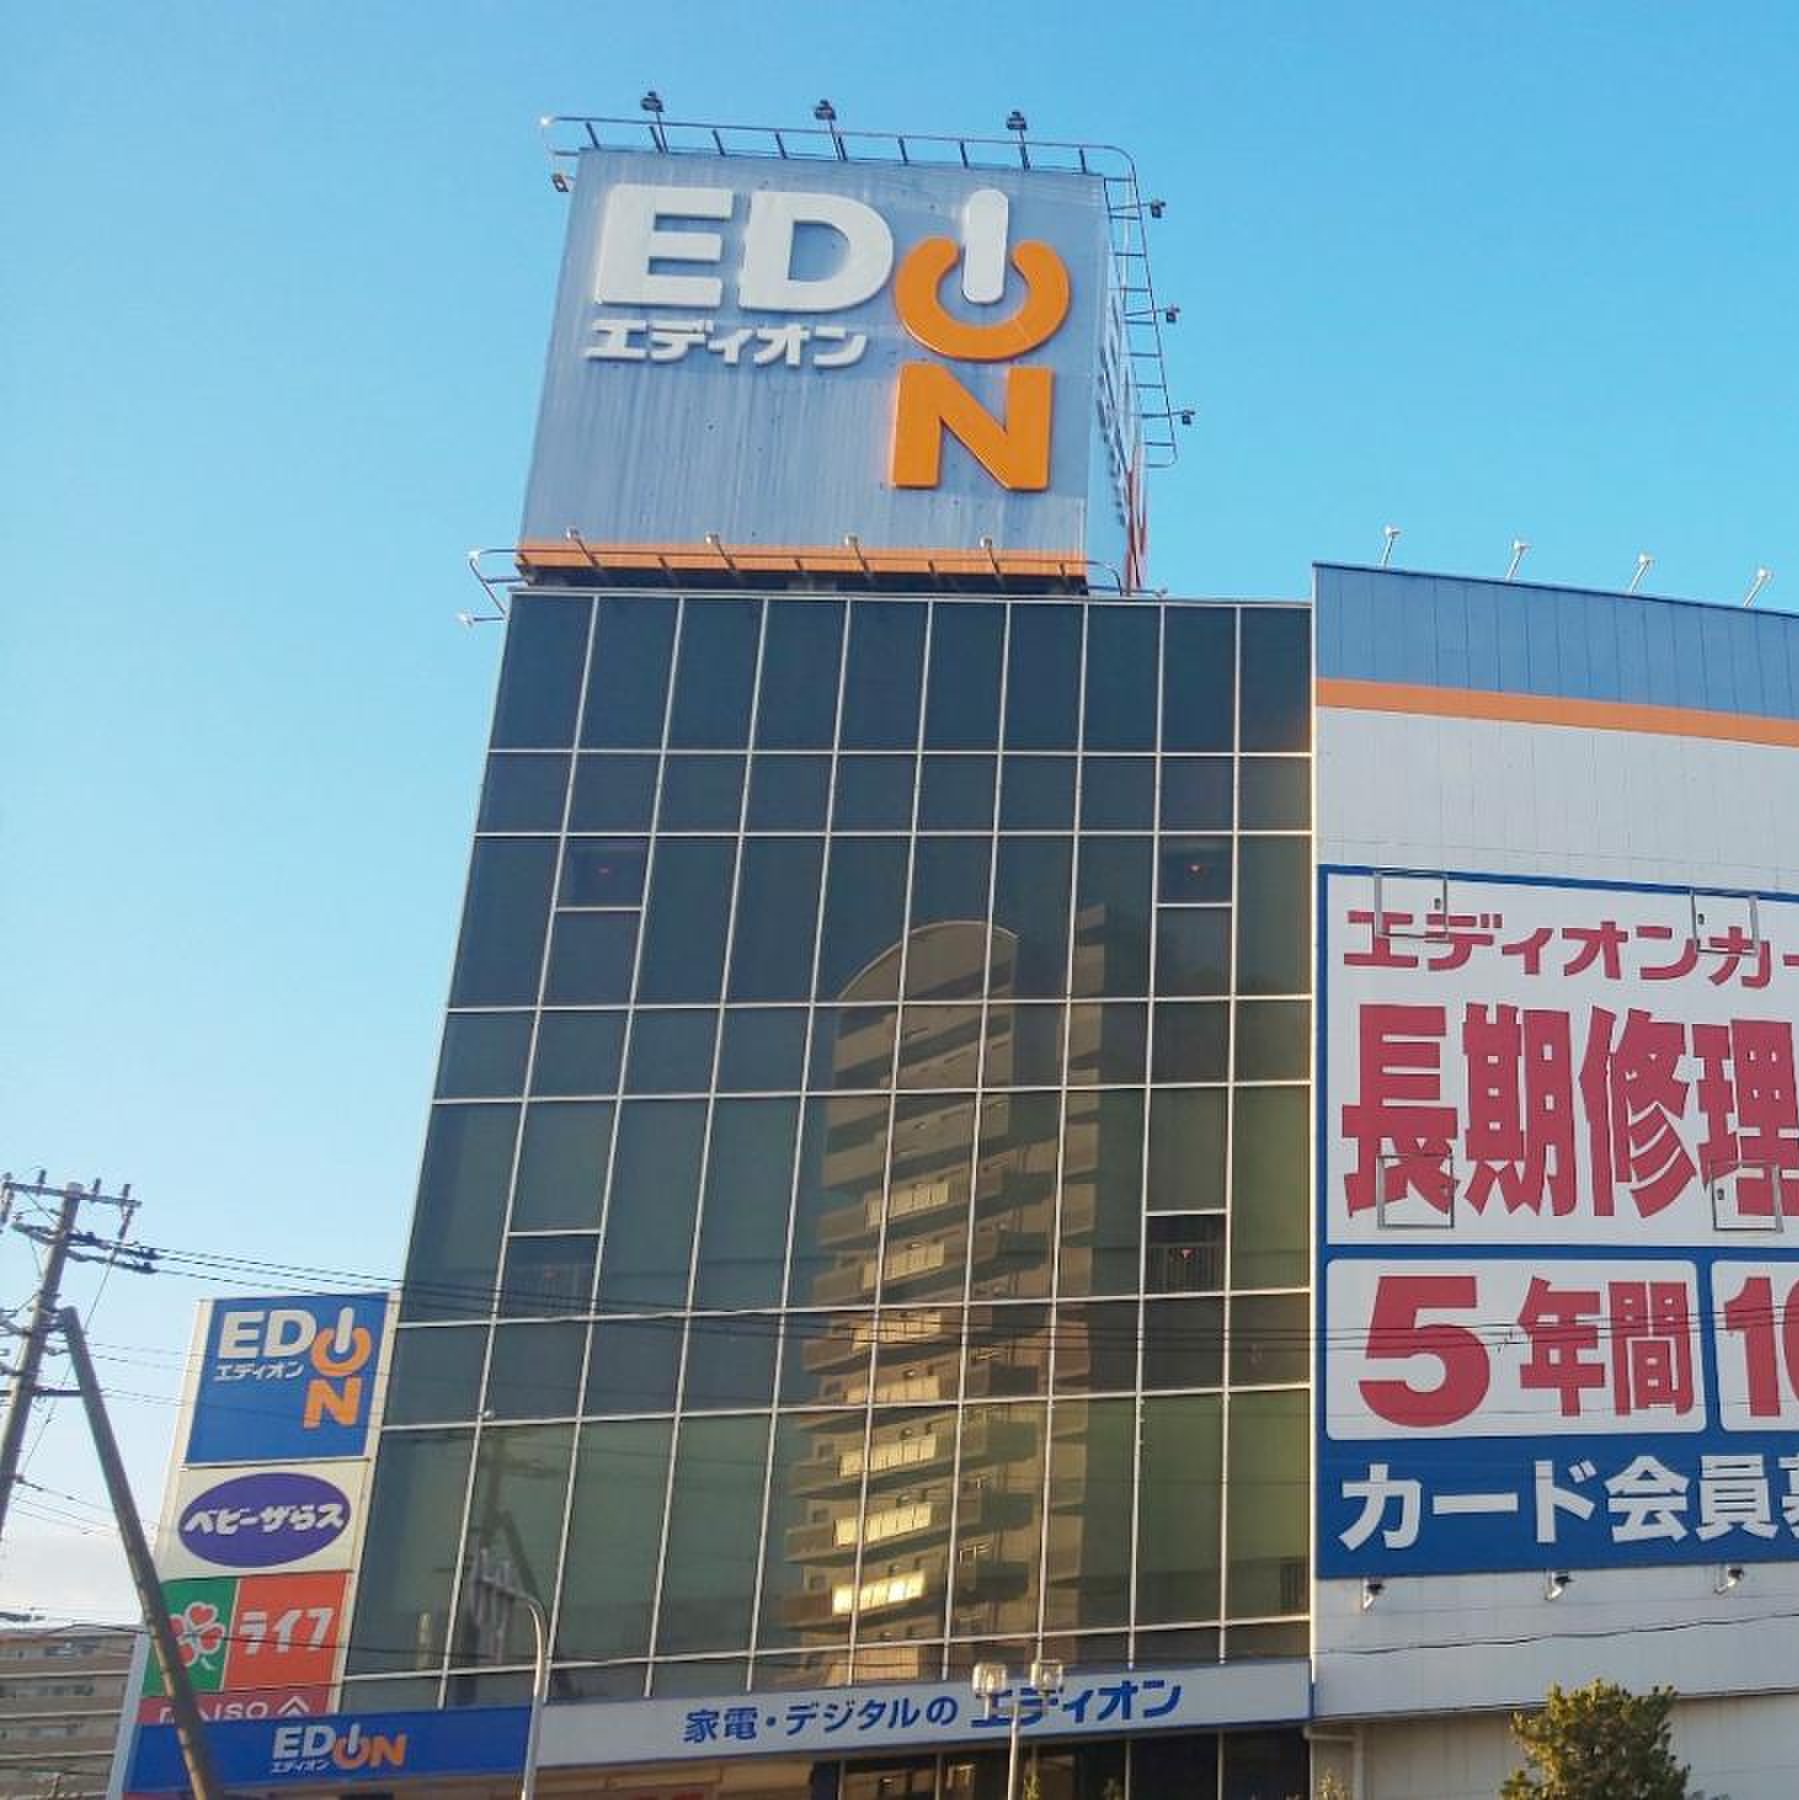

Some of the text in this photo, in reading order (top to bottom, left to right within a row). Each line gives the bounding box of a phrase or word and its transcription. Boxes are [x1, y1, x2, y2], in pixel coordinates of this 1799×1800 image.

[586, 318, 867, 369] エディオン
[214, 1359, 305, 1382] エディオン
[1358, 1275, 1696, 1428] 5年間
[184, 1502, 345, 1537] ベビーザらス
[239, 1606, 337, 1656] ライフ
[160, 1701, 268, 1724] ISO
[684, 1696, 958, 1745] 家電・デジタルの
[272, 1723, 407, 1770] EDION
